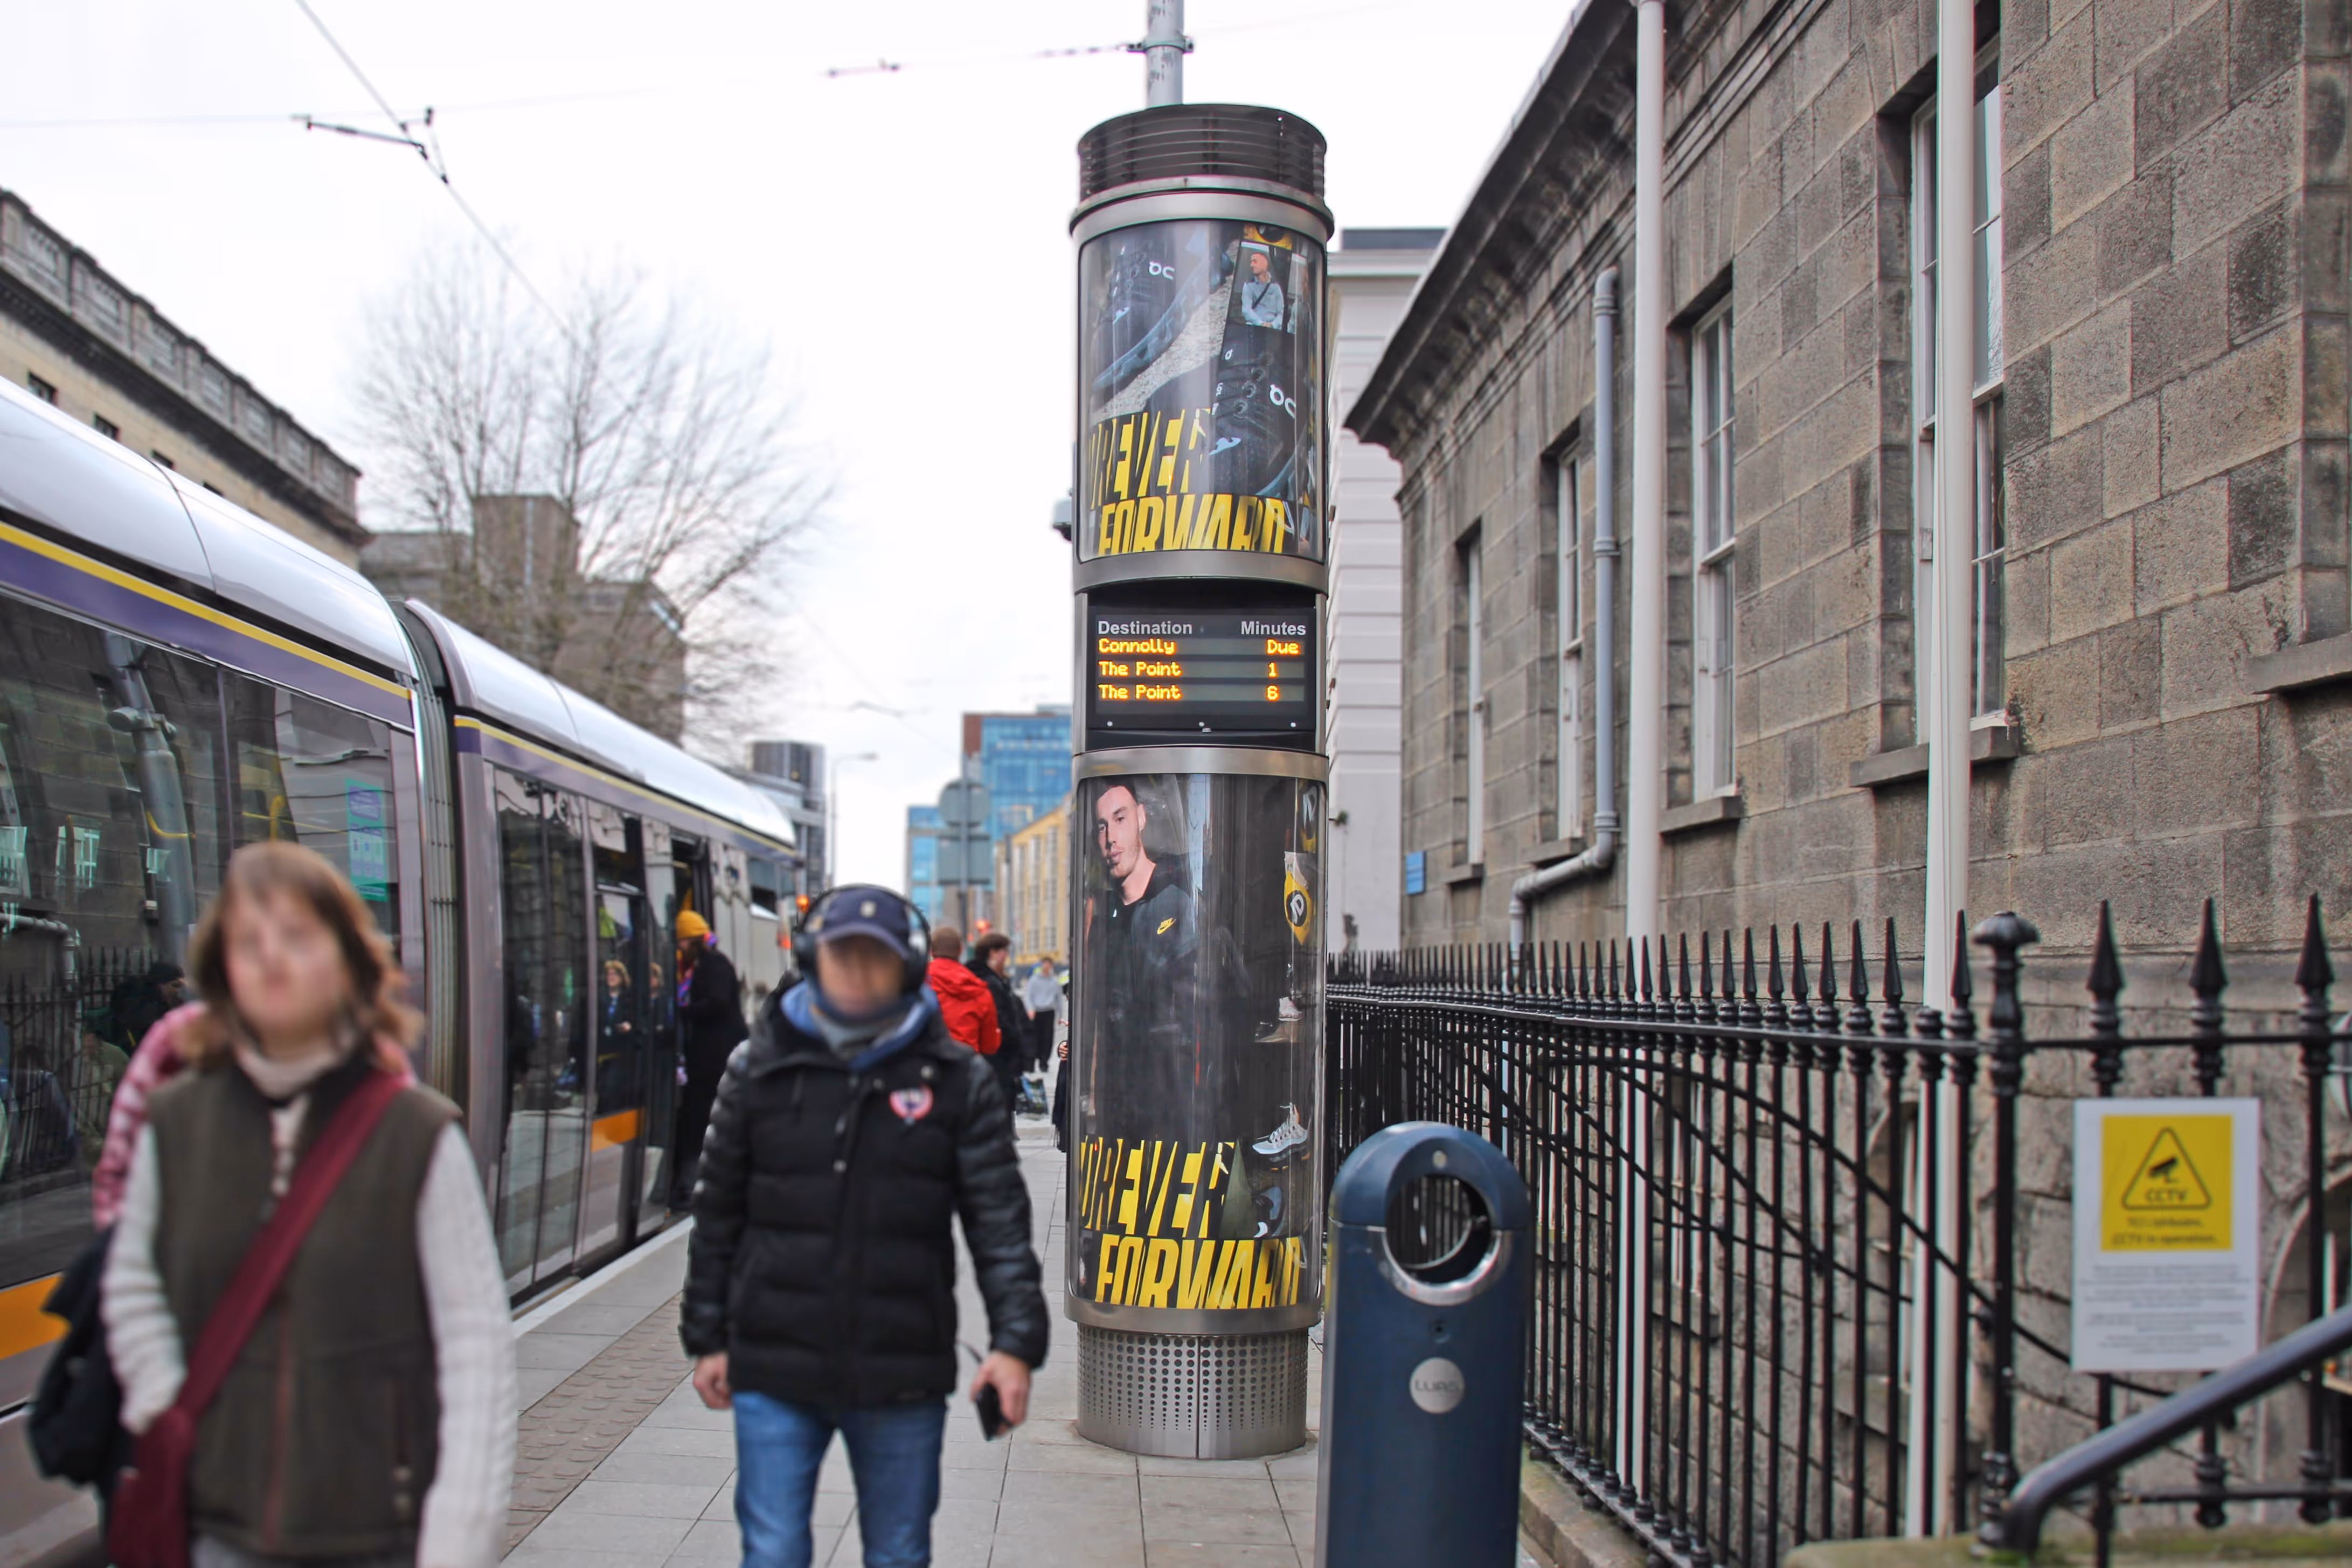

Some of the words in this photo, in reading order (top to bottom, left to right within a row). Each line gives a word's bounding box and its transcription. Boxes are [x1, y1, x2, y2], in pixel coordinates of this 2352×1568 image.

[1098, 493, 1285, 556] FORWARD
[1098, 620, 1192, 635] Destination
[1241, 621, 1306, 635] Minutes
[1098, 638, 1176, 655] Connolly
[1267, 639, 1299, 655] Due
[1098, 661, 1129, 676] The
[1135, 661, 1182, 677] Point
[1268, 662, 1278, 677] 1
[1098, 684, 1129, 700] The
[1135, 684, 1182, 700] Point
[1266, 685, 1279, 700] 6
[1095, 1233, 1301, 1310] FORWARD
